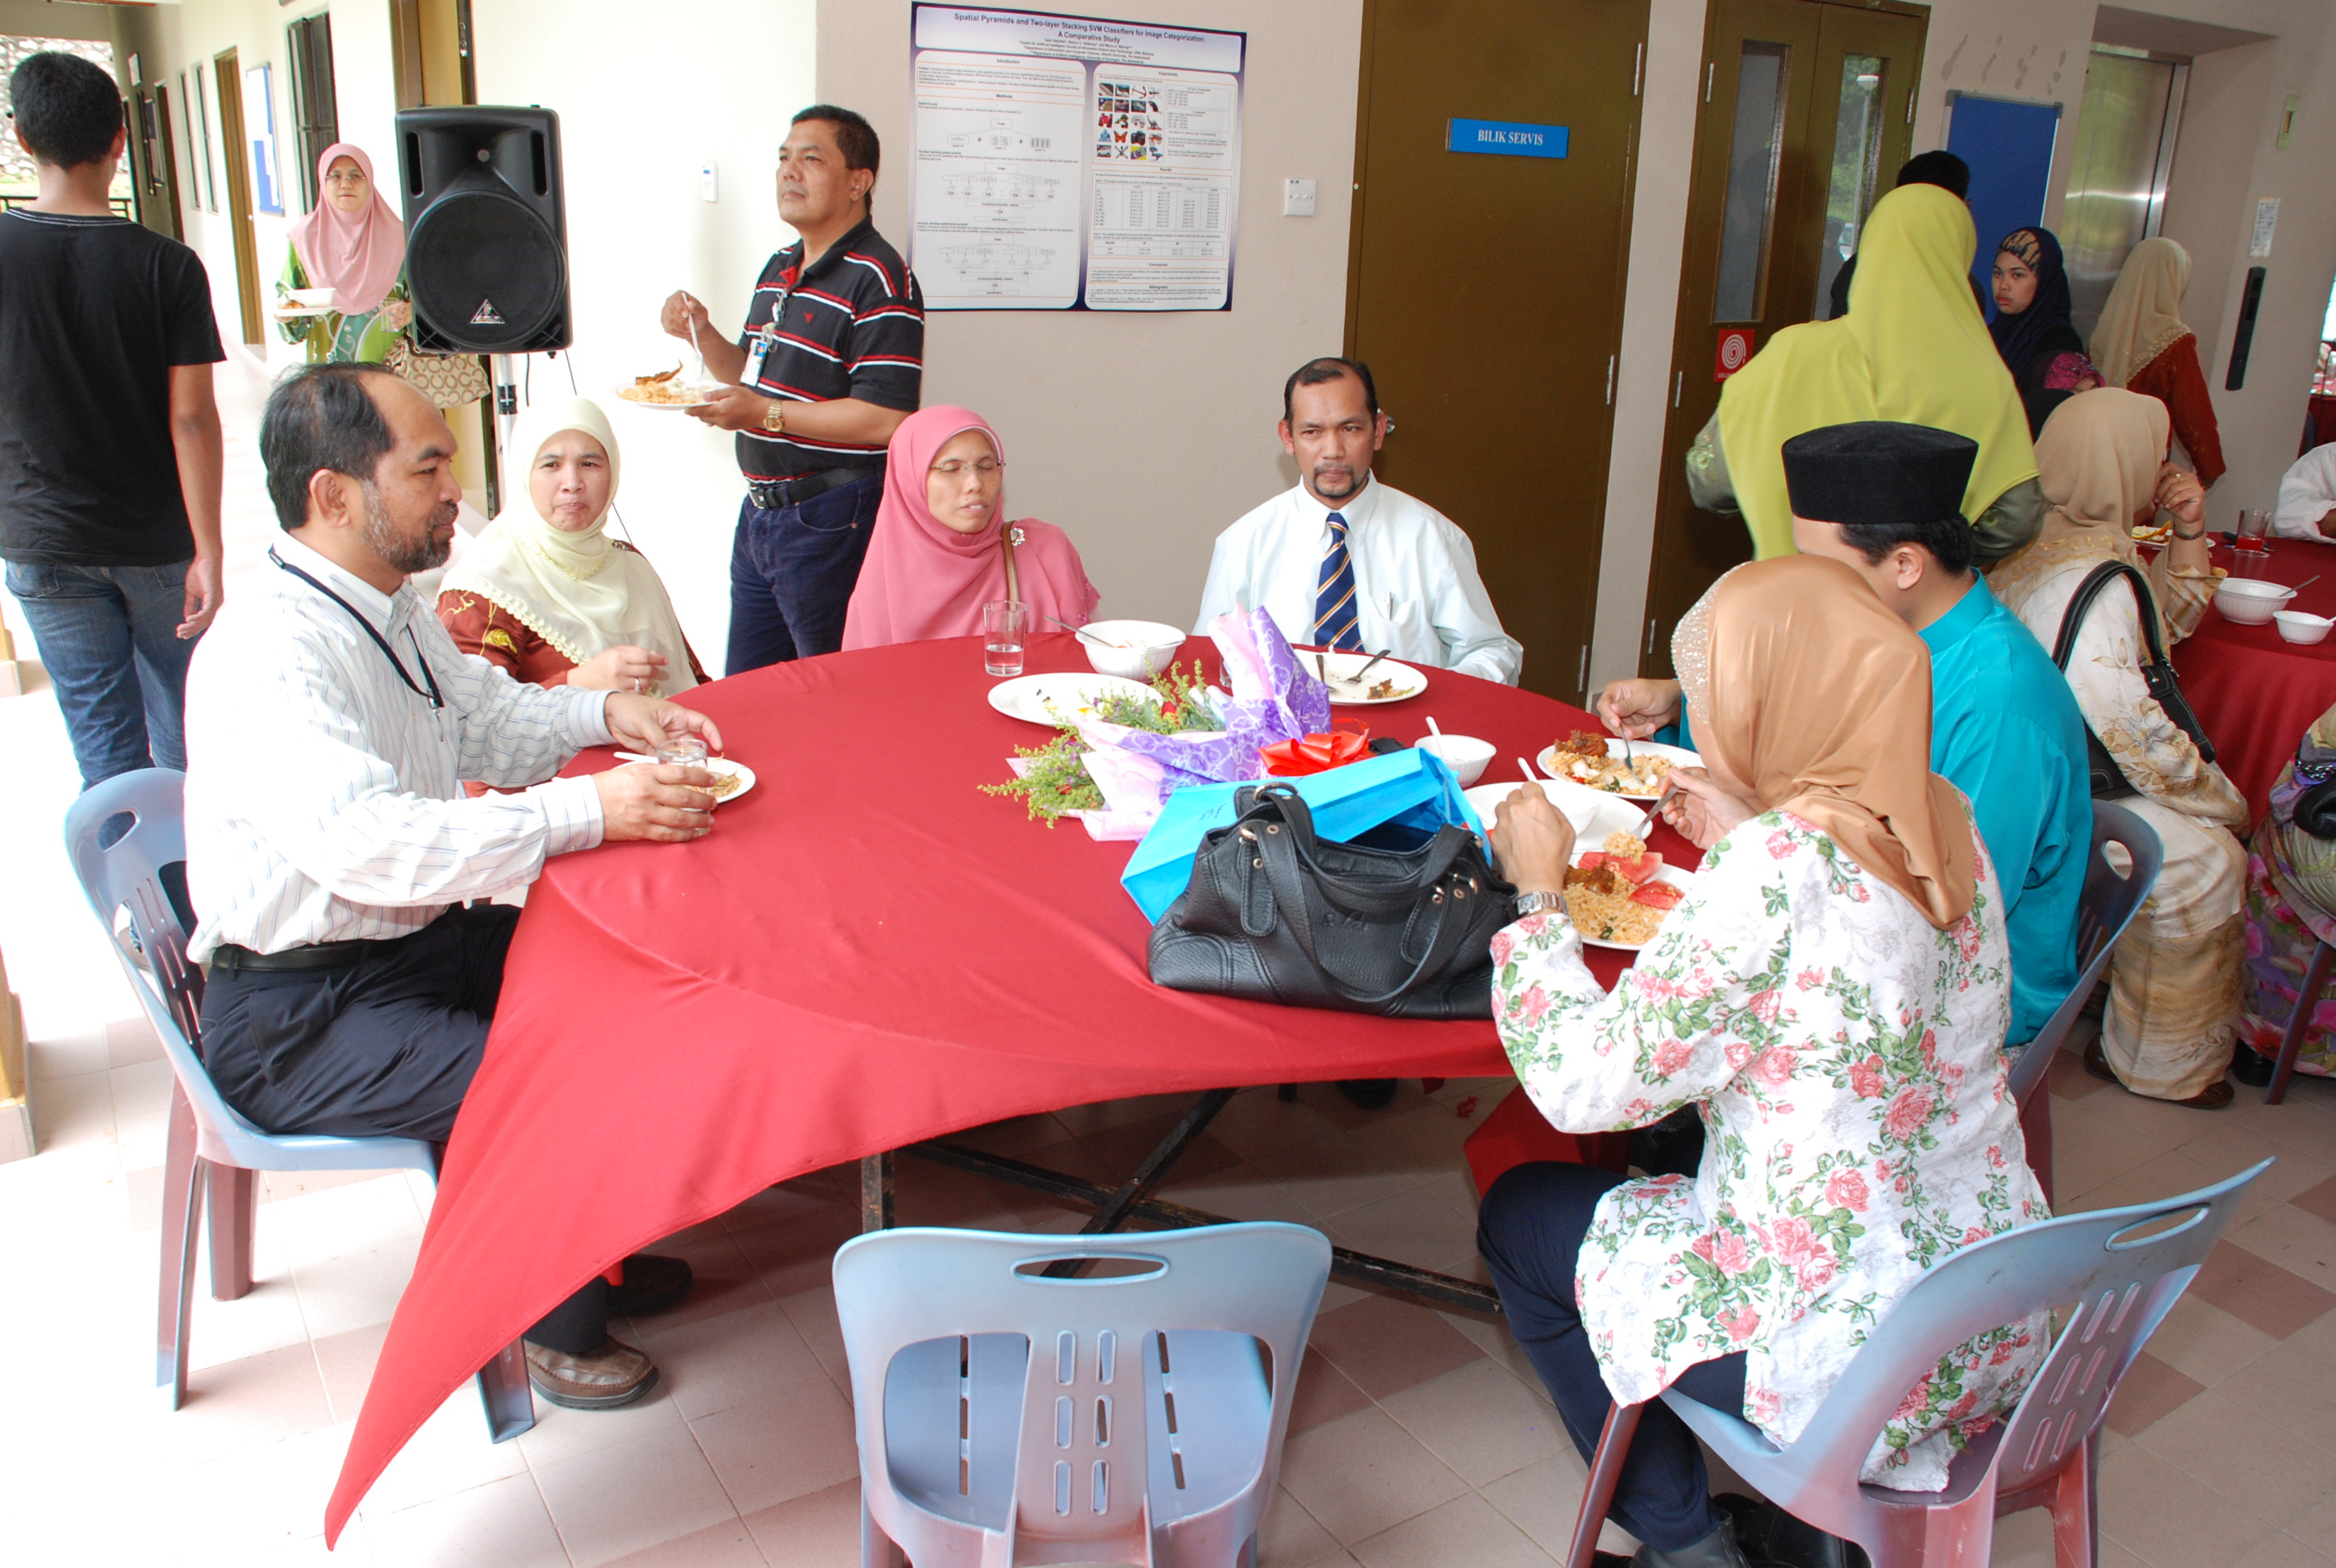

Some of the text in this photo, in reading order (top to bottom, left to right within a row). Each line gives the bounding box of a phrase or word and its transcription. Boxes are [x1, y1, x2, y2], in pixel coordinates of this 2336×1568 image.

[981, 16, 1015, 24] Pyramids
[1031, 19, 1060, 28] Two-layer
[1062, 22, 1087, 31] Stacking
[1089, 24, 1103, 32] SVM
[1103, 27, 1134, 35] Classifiers
[1145, 30, 1162, 39] Image
[1064, 32, 1102, 41] Comparative
[1103, 35, 1120, 44] Study
[1478, 129, 1544, 146] BILIK SERVIS
